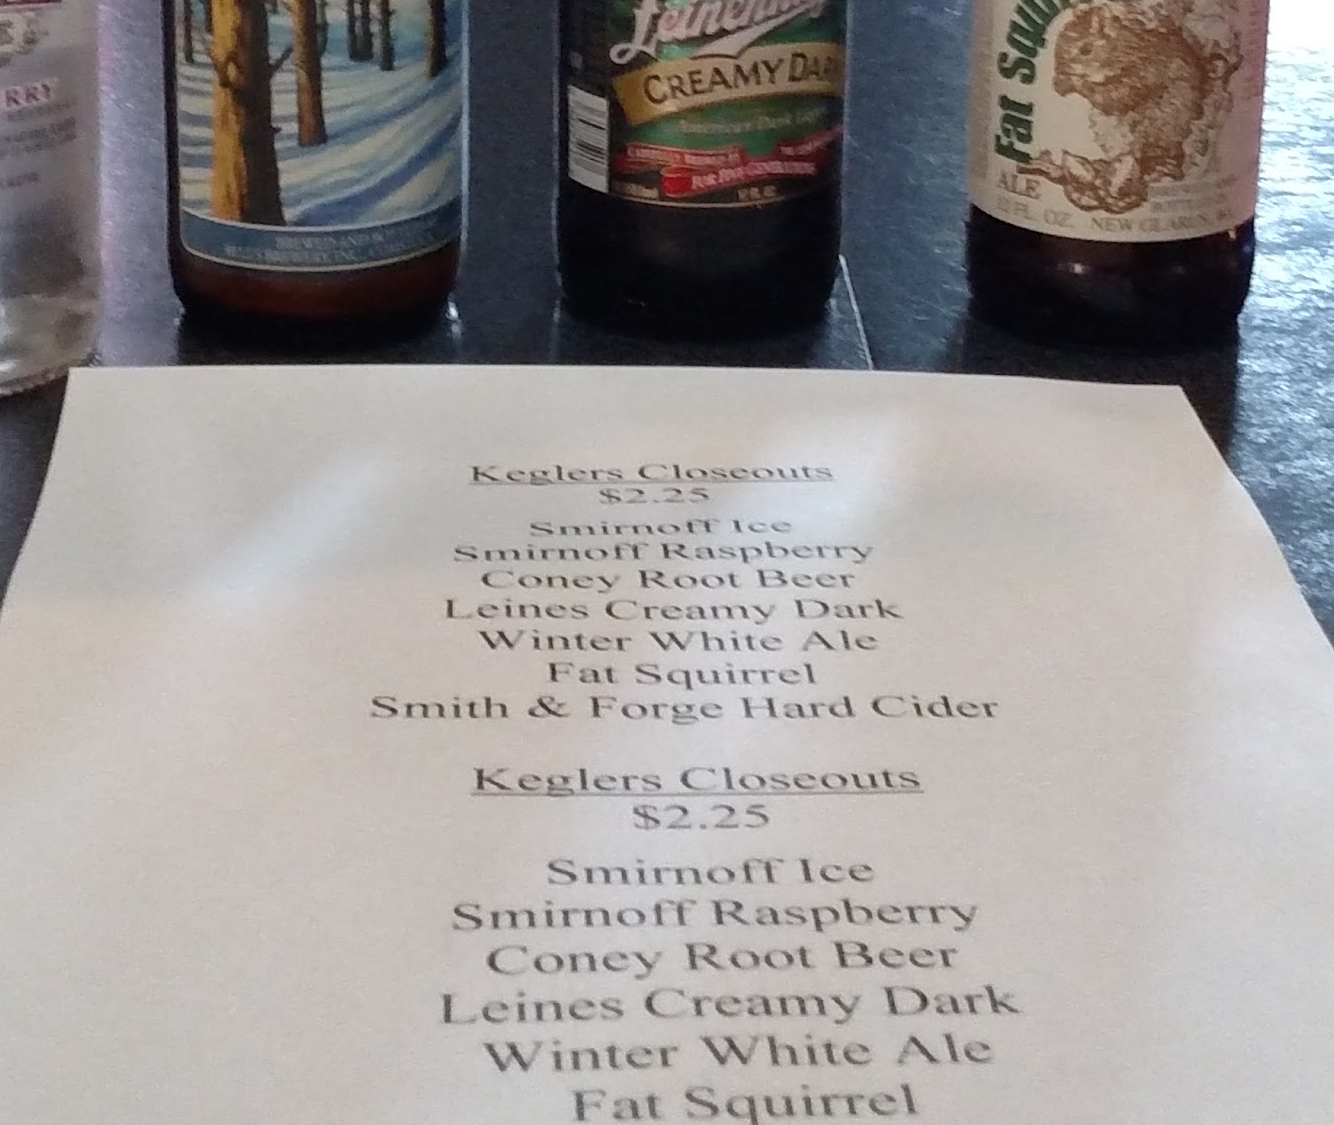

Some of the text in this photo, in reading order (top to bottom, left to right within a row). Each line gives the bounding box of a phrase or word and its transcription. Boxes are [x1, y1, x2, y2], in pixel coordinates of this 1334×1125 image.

[643, 55, 785, 105] CREAMY
[992, 94, 1034, 164] Fat
[995, 173, 1043, 200] ALE
[472, 463, 834, 483] Keglers Closeouts
[529, 518, 792, 537] Smirnoff Ice
[453, 540, 874, 565] Smirnoff Raspberry
[480, 568, 856, 595] Coney Root Beer
[446, 597, 903, 627] Leines Creamy Dark
[478, 628, 877, 653] Winter White Ale
[548, 661, 817, 692] Fat Squirrel
[371, 693, 999, 727] Smith & Forge Hard Cider
[473, 766, 922, 794] Keglers Closeouts
[547, 857, 874, 886] Smirnoff Ice
[452, 897, 979, 934] Smirnoff Raspberry
[486, 940, 958, 981] Coney Root Beer
[442, 983, 1021, 1026] Leines Creamy Dark
[483, 1032, 992, 1074] Winter White Ale
[574, 1082, 918, 1125] Fat Squirrel
